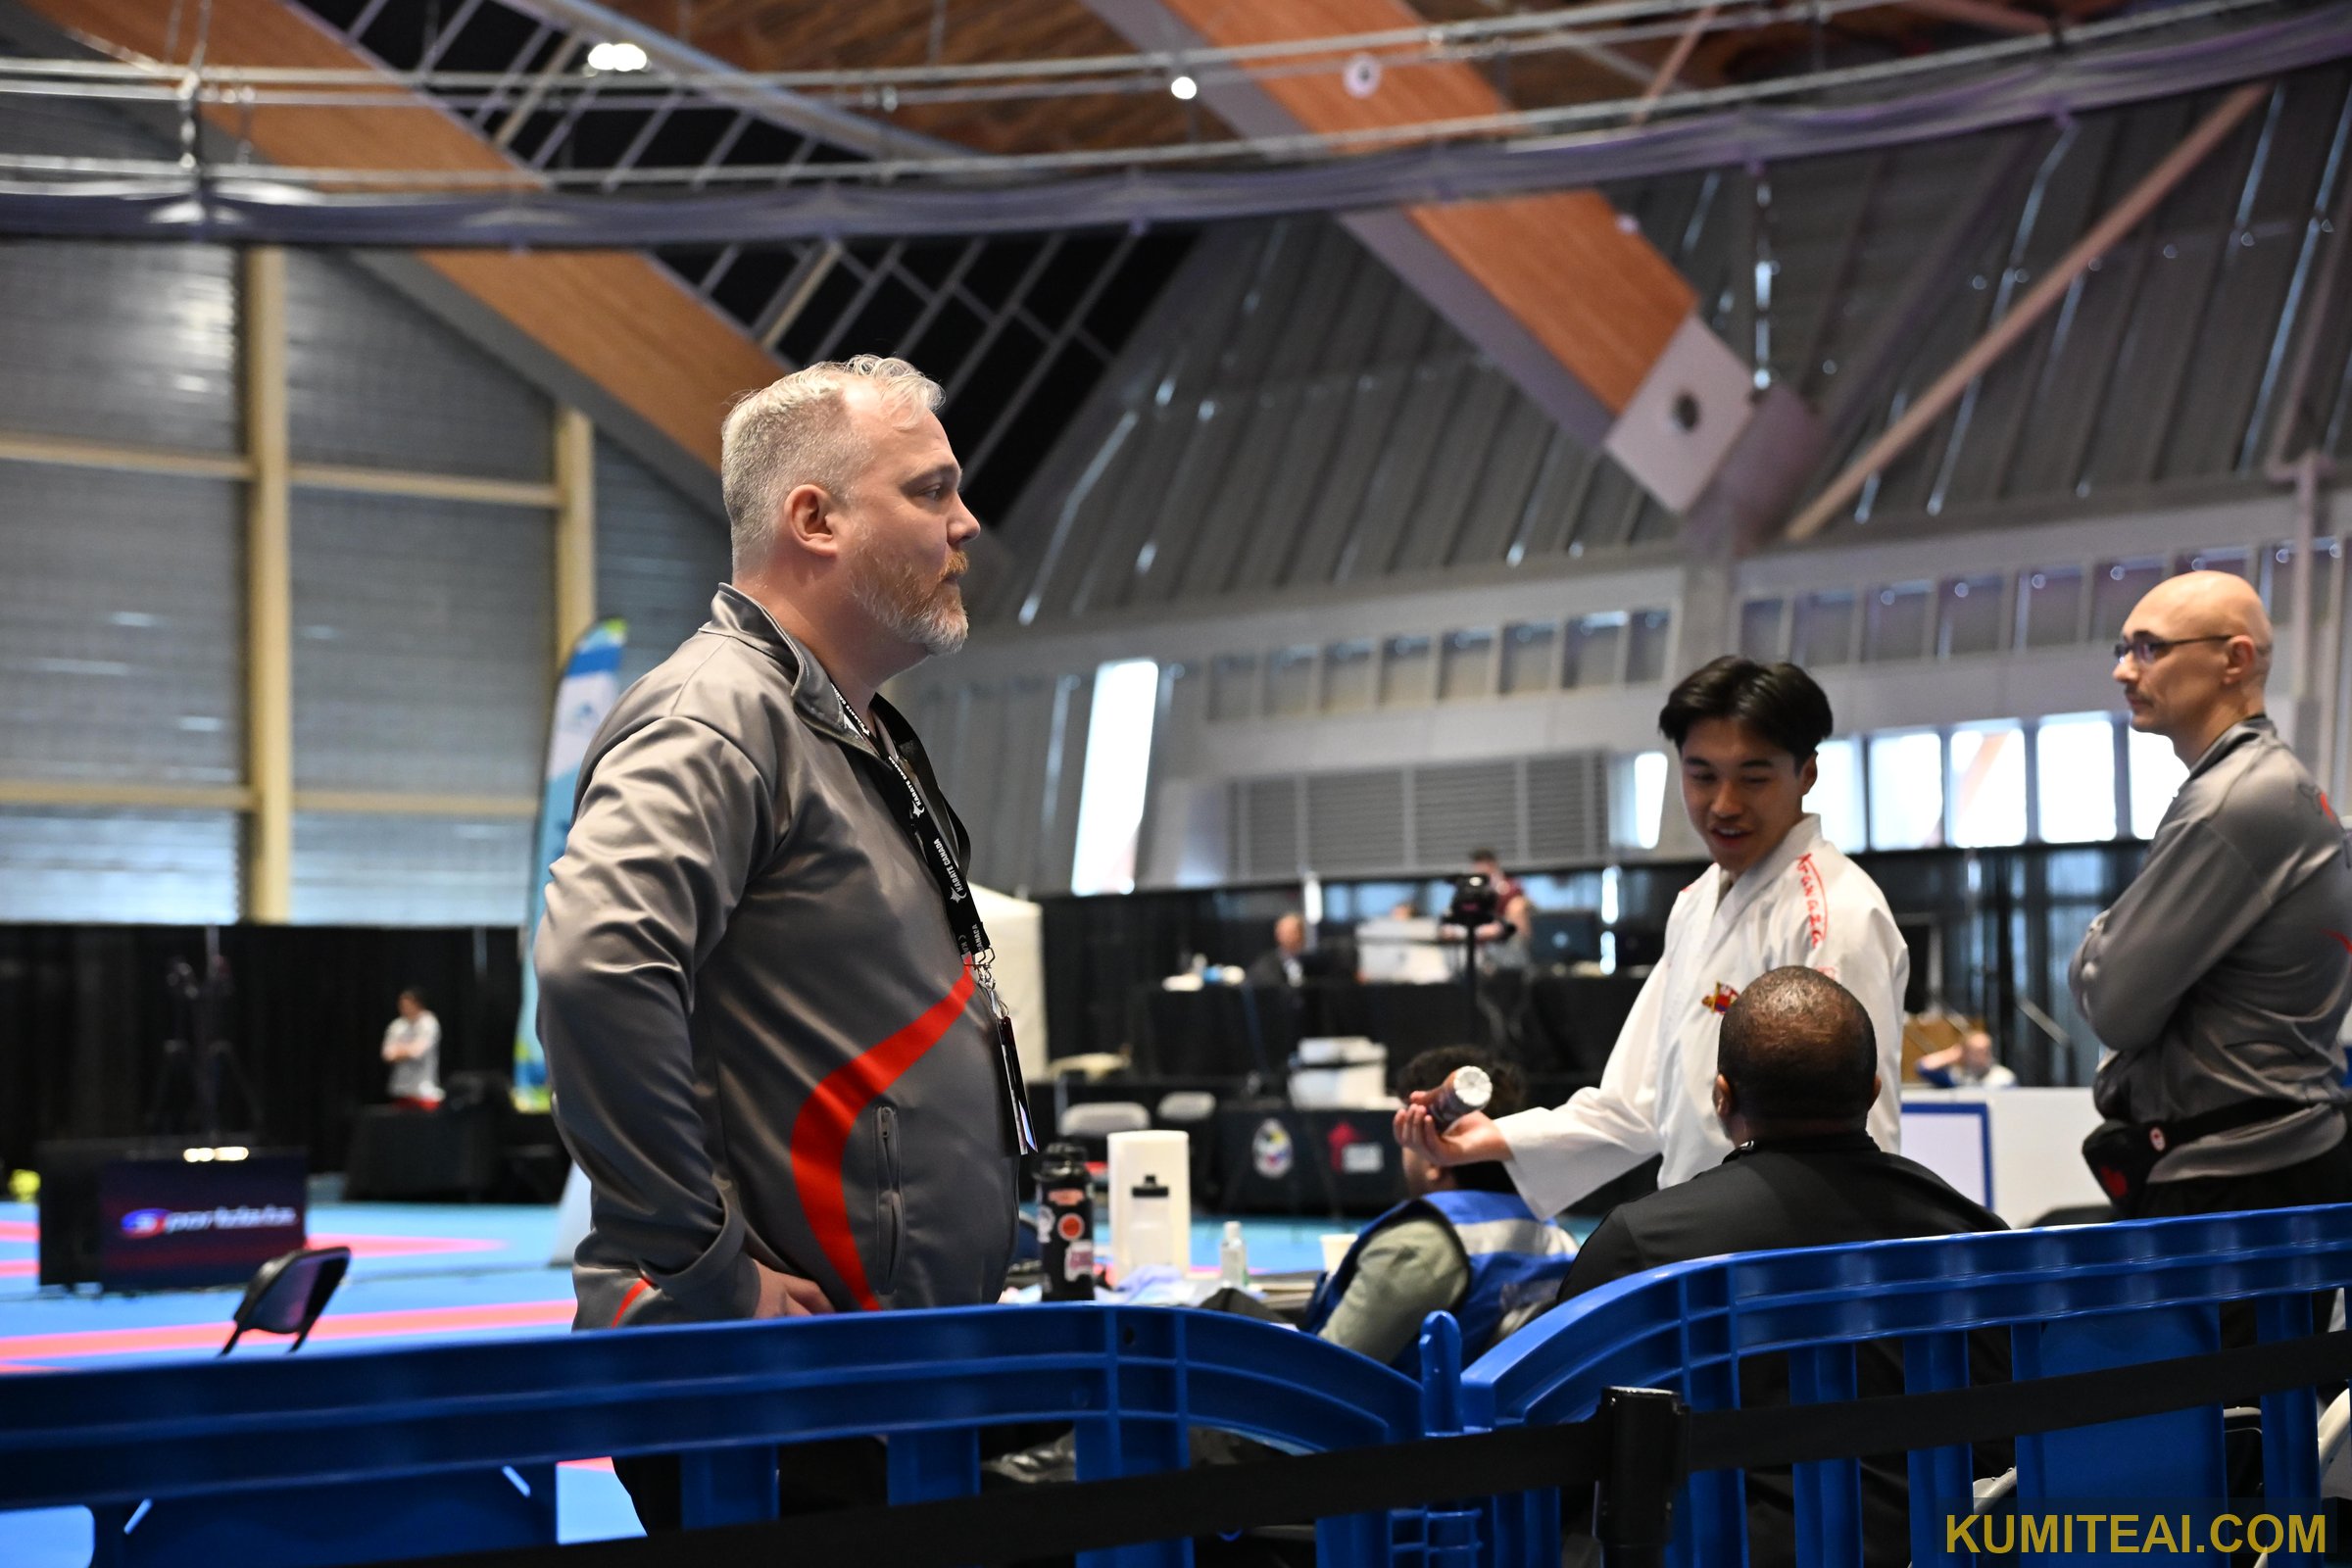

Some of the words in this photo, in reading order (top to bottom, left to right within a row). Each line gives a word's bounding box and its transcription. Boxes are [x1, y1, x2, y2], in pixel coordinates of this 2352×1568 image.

[888, 756, 907, 780] CANADA
[906, 780, 921, 807] KARATE
[933, 838, 951, 866] CANADA
[946, 865, 964, 893] KARATE
